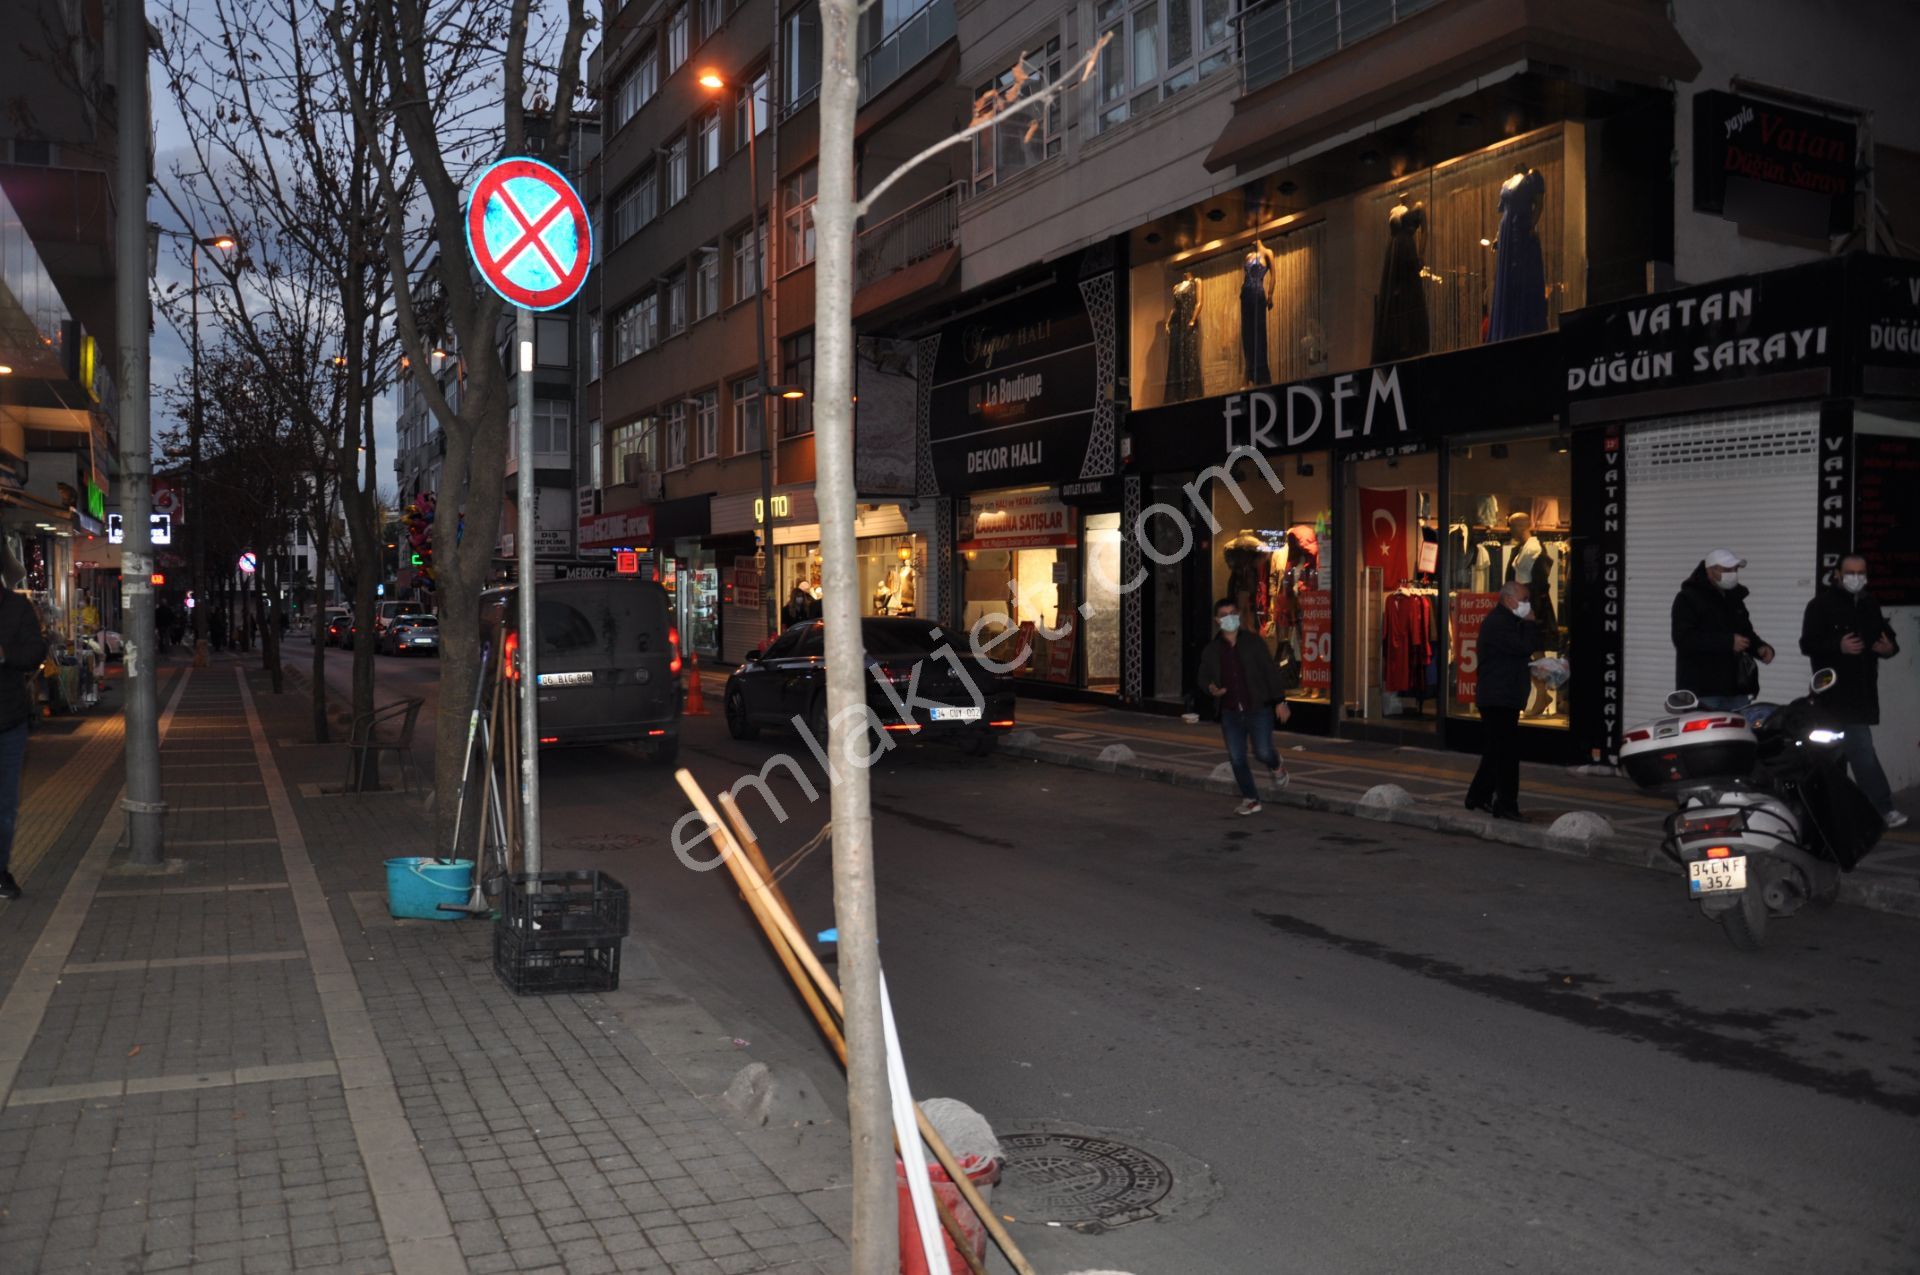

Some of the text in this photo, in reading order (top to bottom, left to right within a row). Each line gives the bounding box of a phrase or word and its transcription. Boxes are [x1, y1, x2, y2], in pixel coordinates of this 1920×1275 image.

[1724, 104, 1755, 139] yayla
[1760, 111, 1848, 162] Vatan
[1627, 287, 1754, 337] VATAN
[1567, 326, 1829, 392] DÜĞÜN SARAYI
[986, 371, 1043, 406] La Boutique
[1222, 364, 1408, 454] ERDEM
[967, 439, 1042, 474] DEKOR HALI
[1063, 483, 1081, 496] OUTLET
[1086, 481, 1102, 494] YATAK
[1823, 436, 1843, 529] VATAN
[1019, 511, 1063, 533] SATIŞLAR
[566, 567, 605, 580] MERKEZ
[1460, 598, 1474, 609] Her
[1602, 452, 1619, 749] VATAN DÜĞÜN SARAYI
[1459, 639, 1478, 674] 5
[1693, 860, 1740, 877] 34 CNF
[1706, 875, 1733, 889] 352
